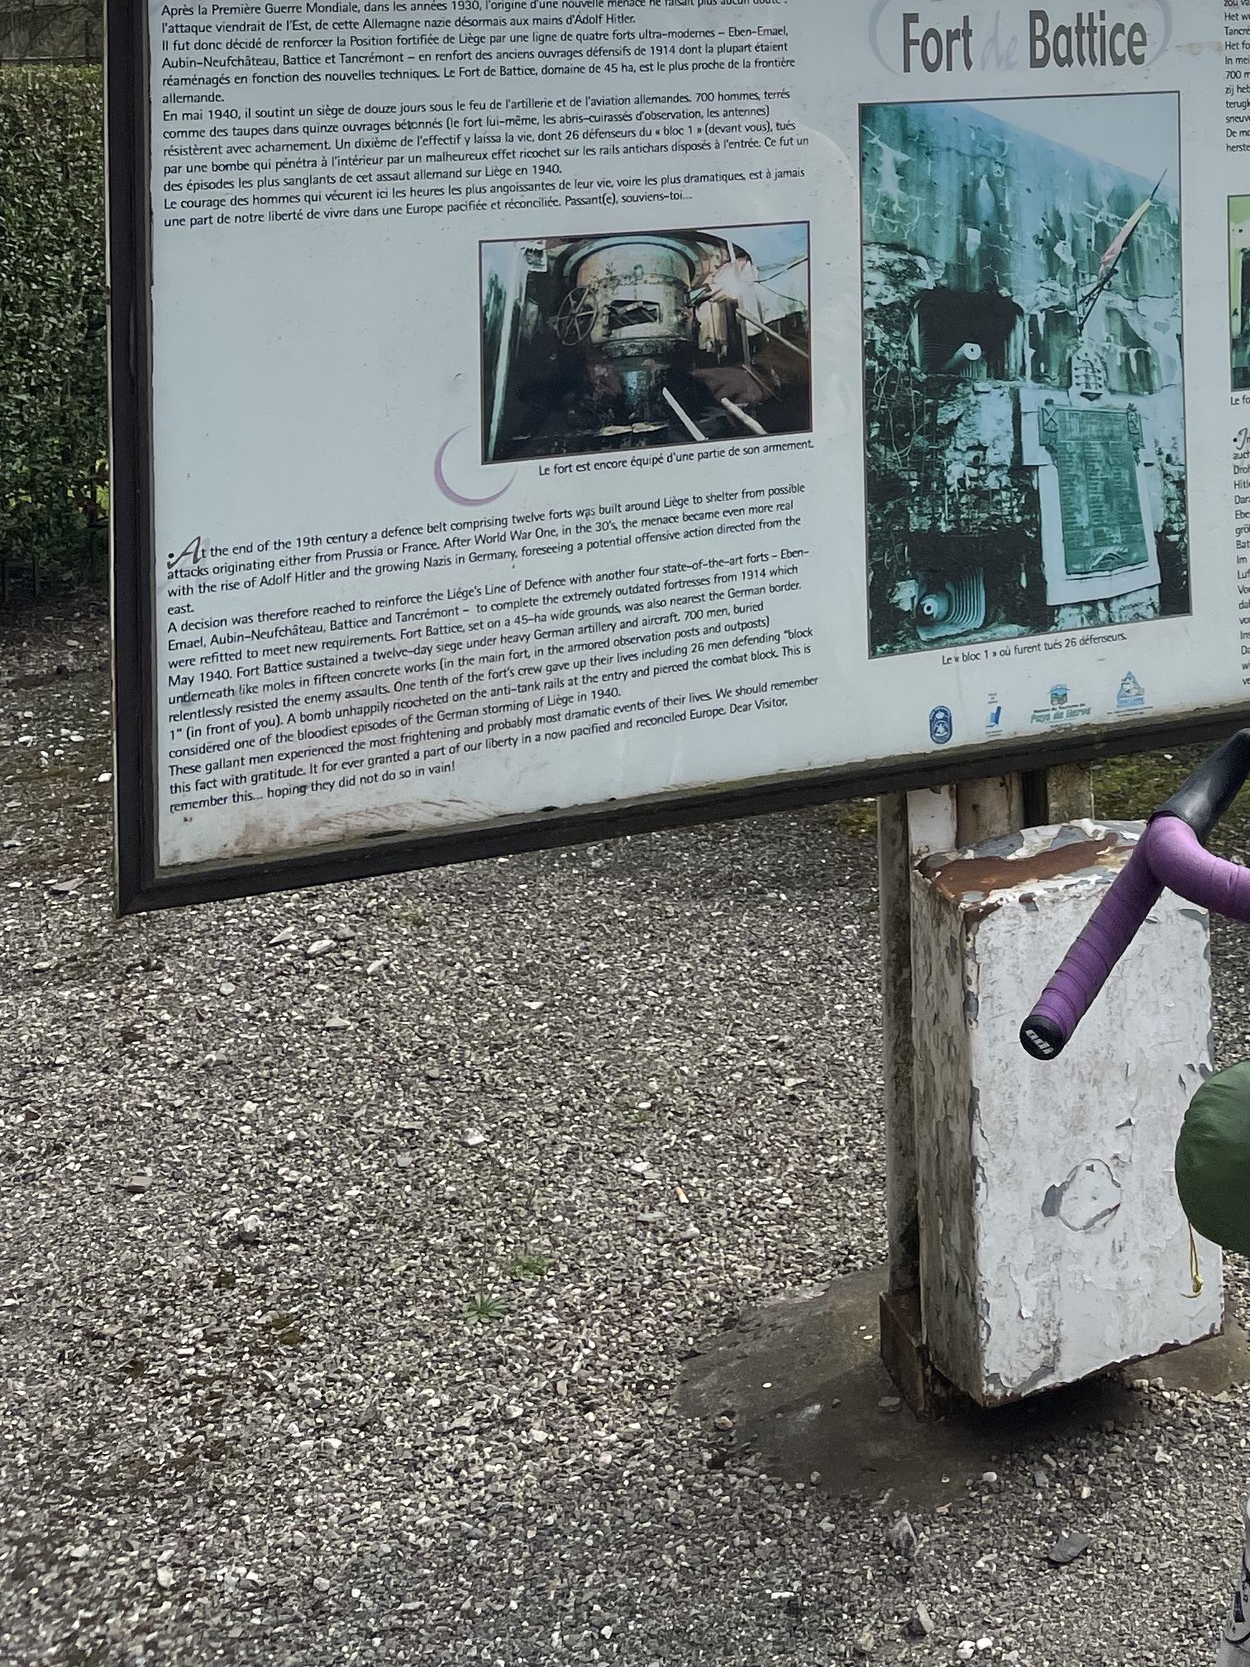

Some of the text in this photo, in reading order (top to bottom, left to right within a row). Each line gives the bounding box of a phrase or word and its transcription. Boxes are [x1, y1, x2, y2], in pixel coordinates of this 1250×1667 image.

[160, 3, 194, 19] Après
[197, 3, 207, 15] la
[211, 2, 261, 15] Première
[264, 2, 302, 14] Guerre
[306, 1, 360, 13] Mondiale,
[363, 1, 389, 12] dans
[393, 0, 407, 12] les
[451, 0, 481, 11] 1930,
[161, 22, 212, 35] l'attaque
[215, 20, 265, 32] viendrait
[268, 19, 282, 31] de
[286, 18, 311, 32] l'Est,
[315, 18, 328, 30] de
[331, 19, 359, 30] cette
[362, 17, 420, 31] Allemagne
[424, 16, 451, 28] nazie
[454, 15, 507, 27] désormais
[509, 17, 529, 26] aux
[532, 14, 563, 26] mains
[605, 12, 635, 24] Hitler.
[903, 13, 973, 73] Fort
[1029, 9, 1147, 69] Battice
[163, 163, 562, 193] des épisodes les plus sanglants de cet assaut allemand sur Liège en 1940.
[1230, 395, 1240, 406] Le
[538, 439, 814, 476] Le fort est encore équipé d'une partie de son armement.
[168, 600, 763, 687] May 1940. Fort Battice sustained a twelve-day siege under heavy German artillery and aircraft. 700 men, buried
[941, 654, 952, 665] Le
[961, 651, 981, 662] bloc
[999, 645, 1011, 657] où
[1013, 642, 1041, 655] furent
[1043, 638, 1062, 651] tués
[1064, 636, 1077, 648] 26
[1078, 632, 1127, 646] défenseurs.
[168, 739, 230, 758] considered
[234, 738, 255, 749] one
[258, 732, 272, 746] of
[275, 731, 294, 744] the
[297, 724, 347, 740] bloodiest
[351, 717, 397, 735] episodes
[400, 713, 413, 726] of
[415, 712, 433, 724] the
[436, 708, 479, 721] German
[482, 700, 529, 715] storming
[532, 695, 544, 708] of
[577, 691, 587, 702] in
[591, 686, 621, 700] 1940.
